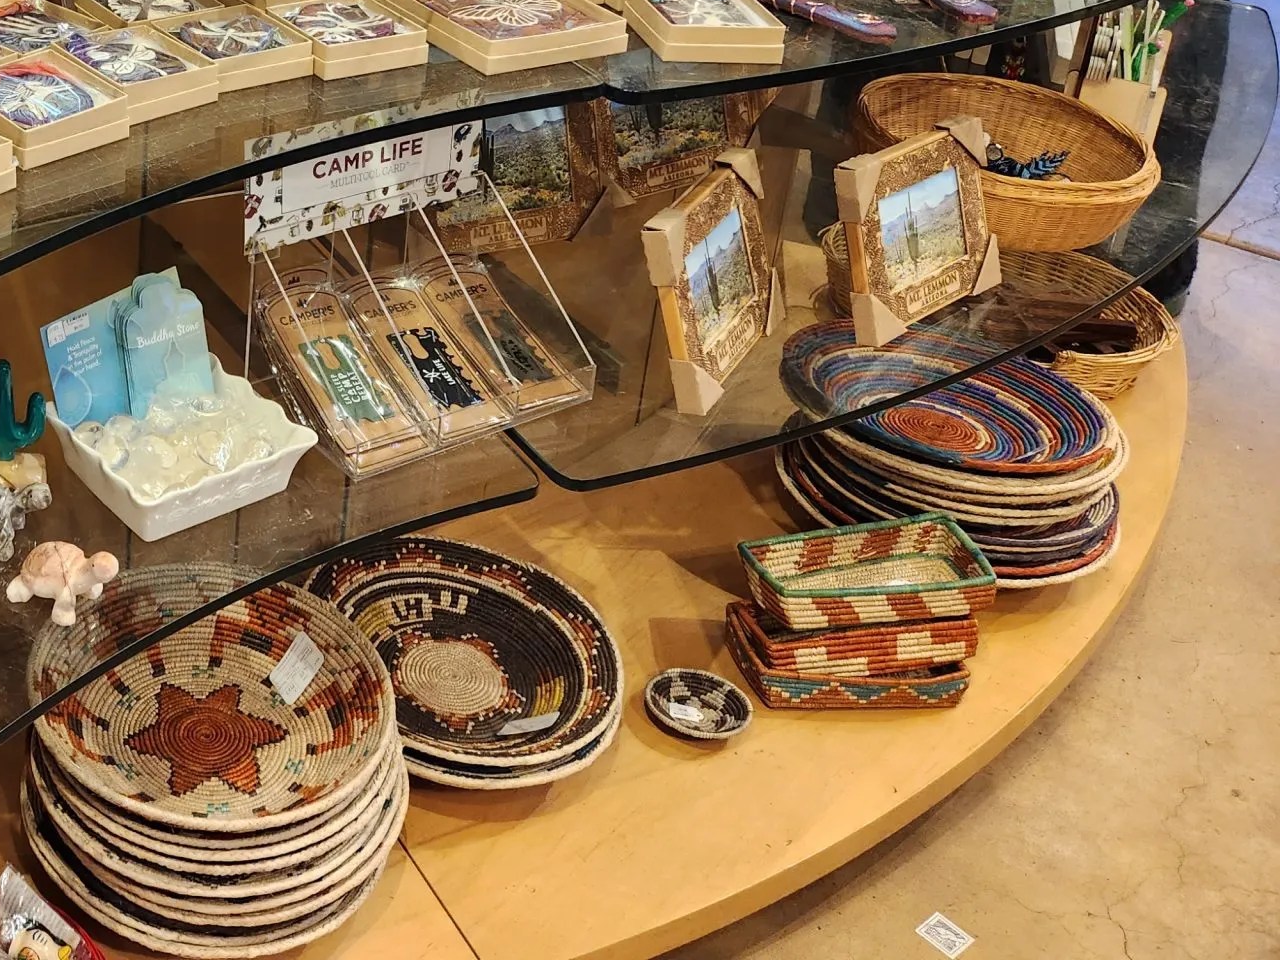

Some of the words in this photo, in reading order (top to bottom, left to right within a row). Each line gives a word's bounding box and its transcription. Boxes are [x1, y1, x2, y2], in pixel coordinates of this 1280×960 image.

[313, 150, 374, 179] CAMP
[380, 137, 423, 164] LIFE
[648, 167, 665, 180] MT.
[666, 155, 706, 173] LEMMON
[663, 169, 695, 182] ARIZONA
[436, 283, 488, 303] CAMPER'S
[908, 292, 922, 305] MT.
[923, 270, 958, 296] LEMMON
[921, 290, 948, 306] ARIZONA
[280, 305, 335, 326] CAMPER'S
[365, 299, 417, 320] CAMPER'S
[136, 329, 174, 349] Buddha
[176, 321, 201, 337] Stone
[728, 319, 753, 352] LEMMON
[432, 358, 446, 373] LIFE
[338, 372, 361, 403] CAMP
[441, 371, 456, 386] LAKE
